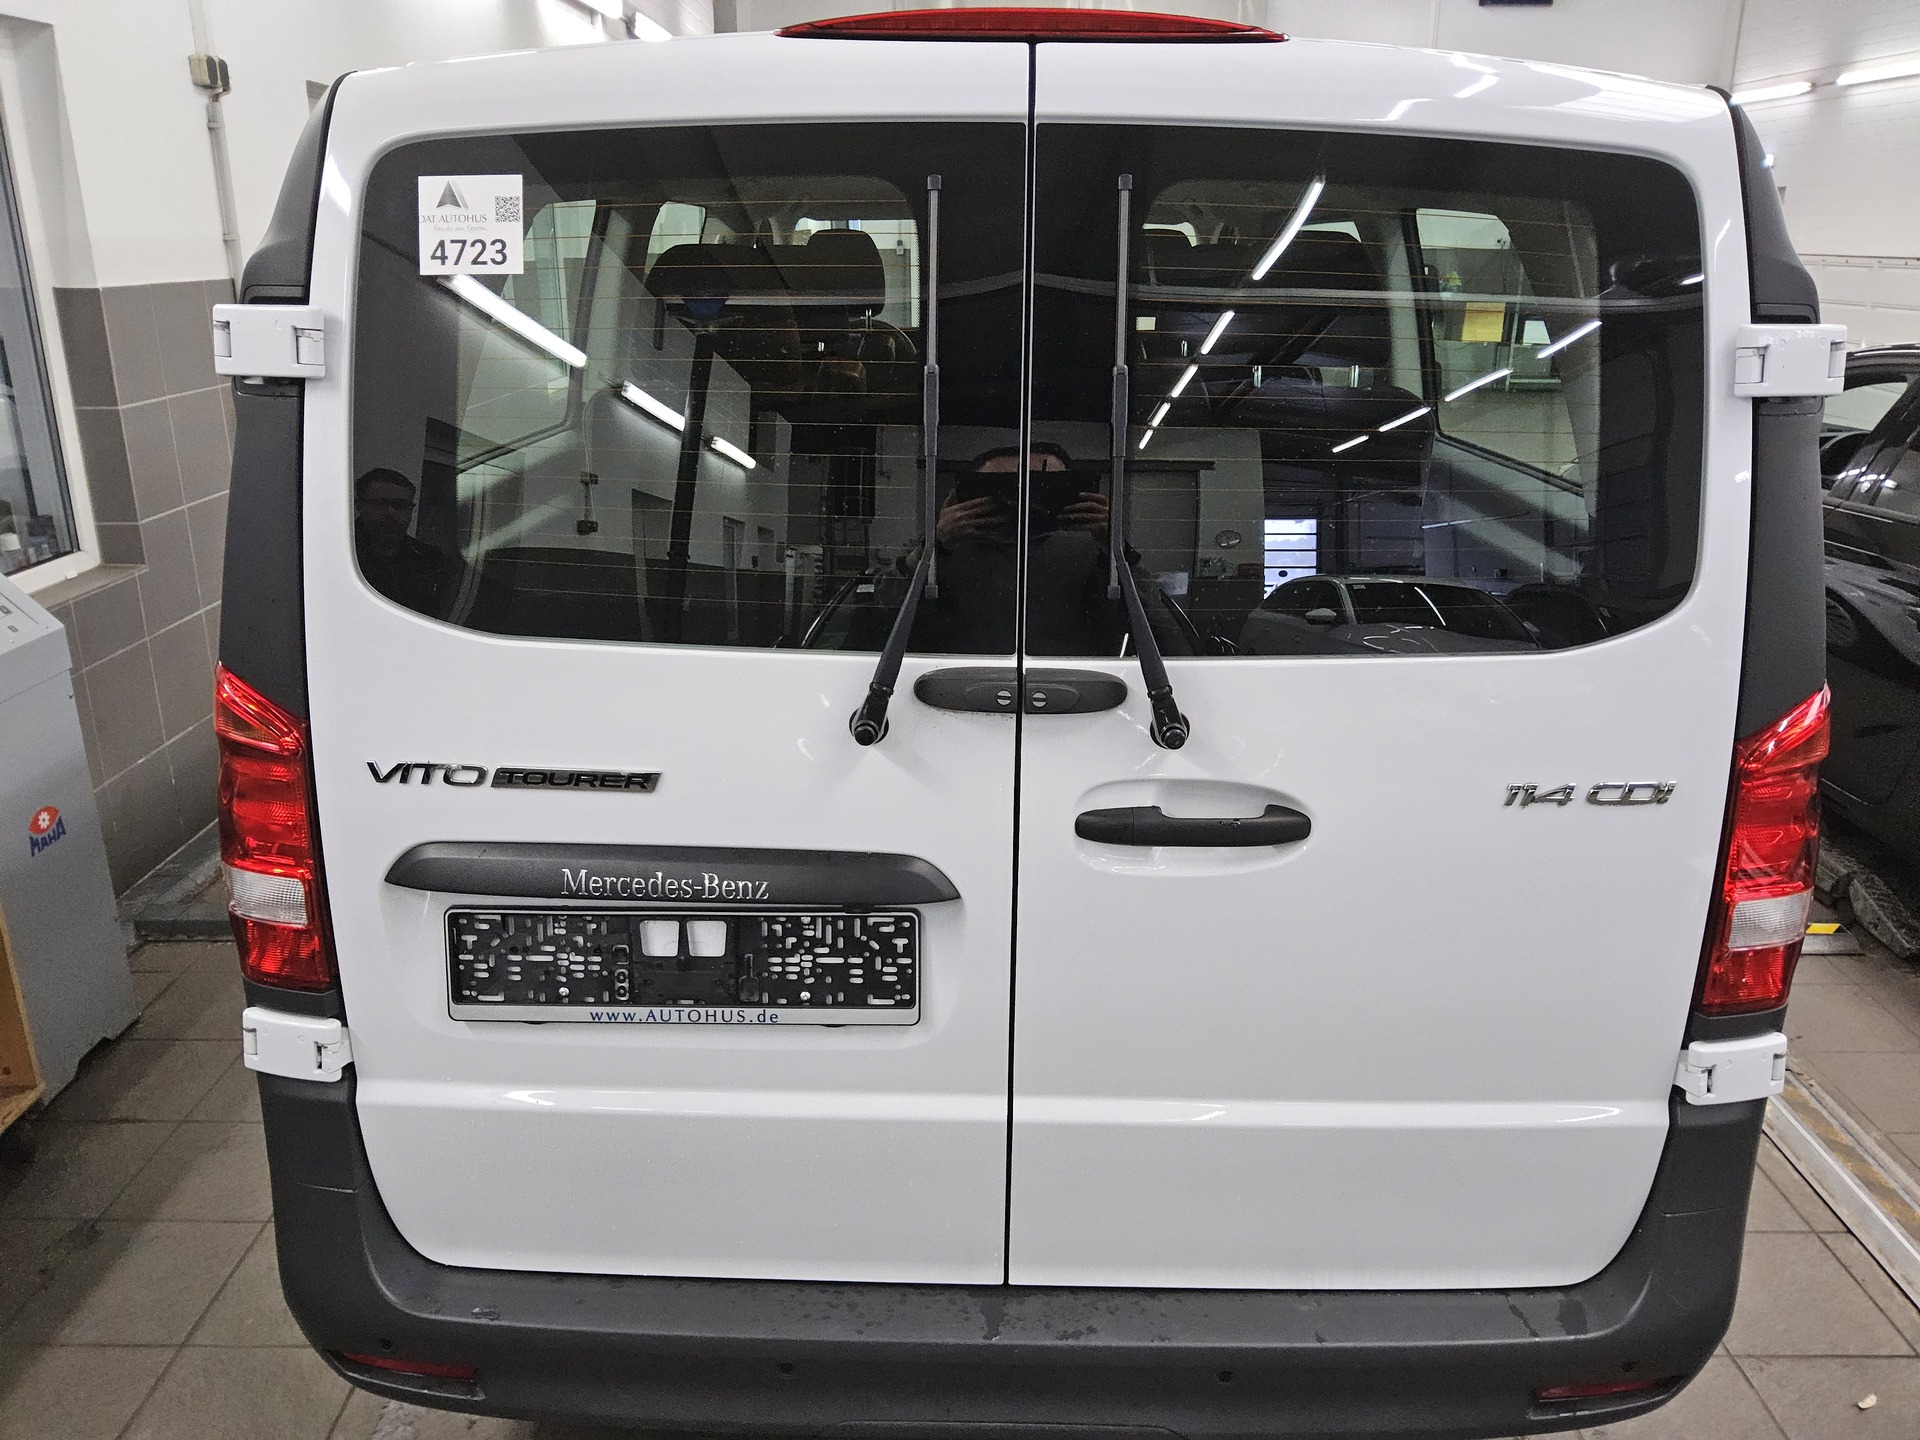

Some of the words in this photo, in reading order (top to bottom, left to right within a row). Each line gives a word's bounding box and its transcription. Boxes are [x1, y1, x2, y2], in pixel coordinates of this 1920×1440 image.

[439, 214, 488, 223] AUTOHUS
[430, 238, 508, 266] 4723
[366, 759, 488, 787] VITO
[498, 769, 657, 791] TOURER
[1503, 782, 1576, 808] 114
[29, 816, 66, 857] MAHA
[561, 869, 770, 900] Mercedes-Benz
[589, 1009, 779, 1024] www.AUTOHUS.de
